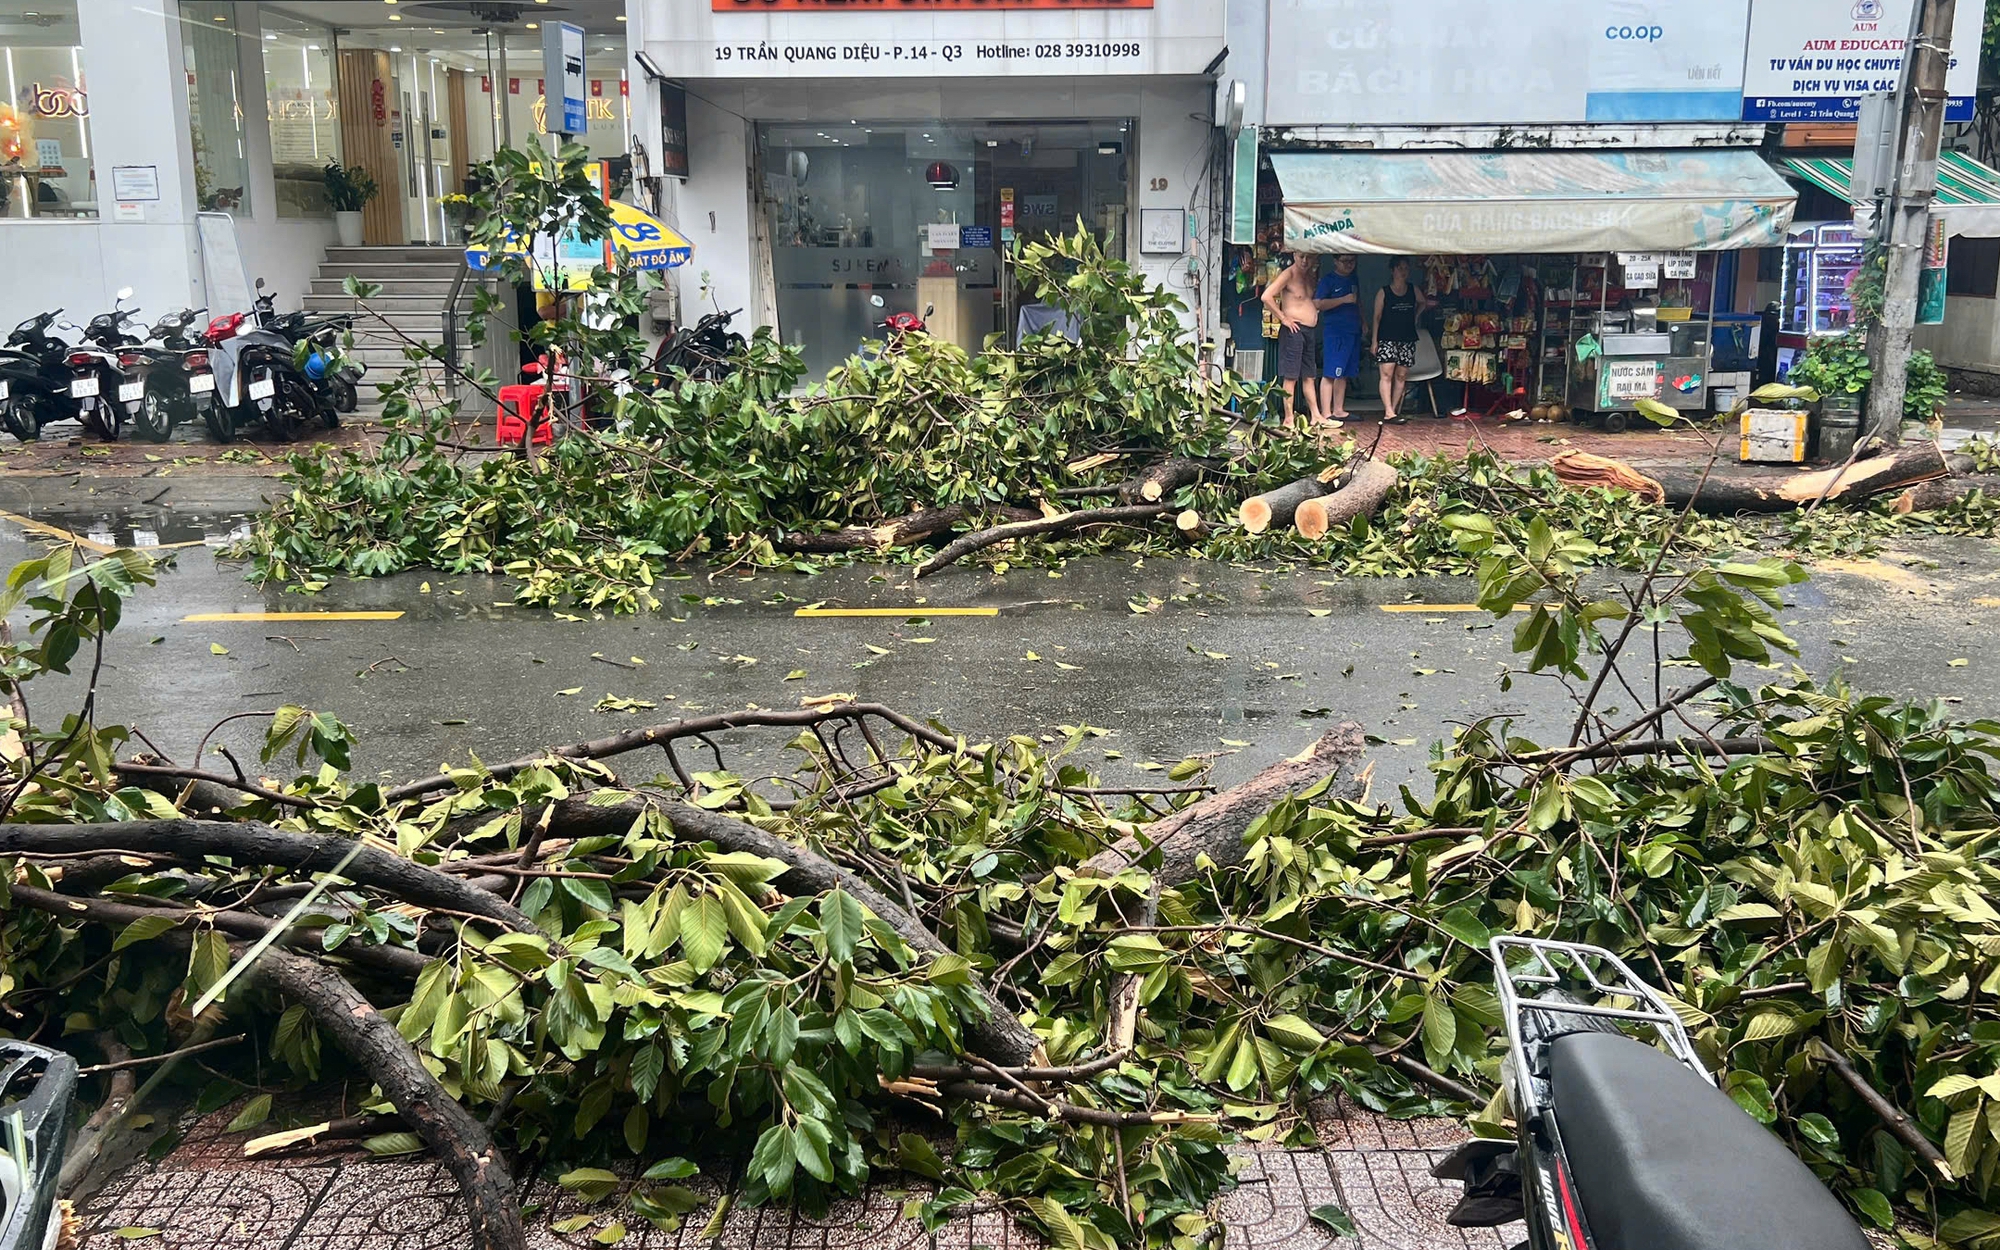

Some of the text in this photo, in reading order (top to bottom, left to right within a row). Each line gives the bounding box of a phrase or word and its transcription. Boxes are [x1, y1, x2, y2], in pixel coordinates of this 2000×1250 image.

[1605, 26, 1663, 43] co.op
[1852, 23, 1878, 31] AUM
[715, 47, 732, 60] 19
[737, 41, 778, 60] TRẦN
[784, 47, 836, 62] QUANG
[843, 43, 880, 62] DIỆU
[894, 47, 927, 60] P.14
[942, 45, 962, 61] Q3
[977, 45, 1030, 58] Hotline:
[1035, 45, 1061, 58] 028
[1066, 44, 1140, 57] 39310998
[1802, 40, 1907, 50] AUM EDUCATI
[1770, 56, 1901, 73] TƯ VẤN DU HỌC CHUYÊ
[1793, 80, 1820, 94] DỊCH
[1825, 80, 1839, 94] VỤ
[1844, 80, 1869, 91] VISA
[1150, 178, 1168, 191] 19
[610, 218, 661, 242] be
